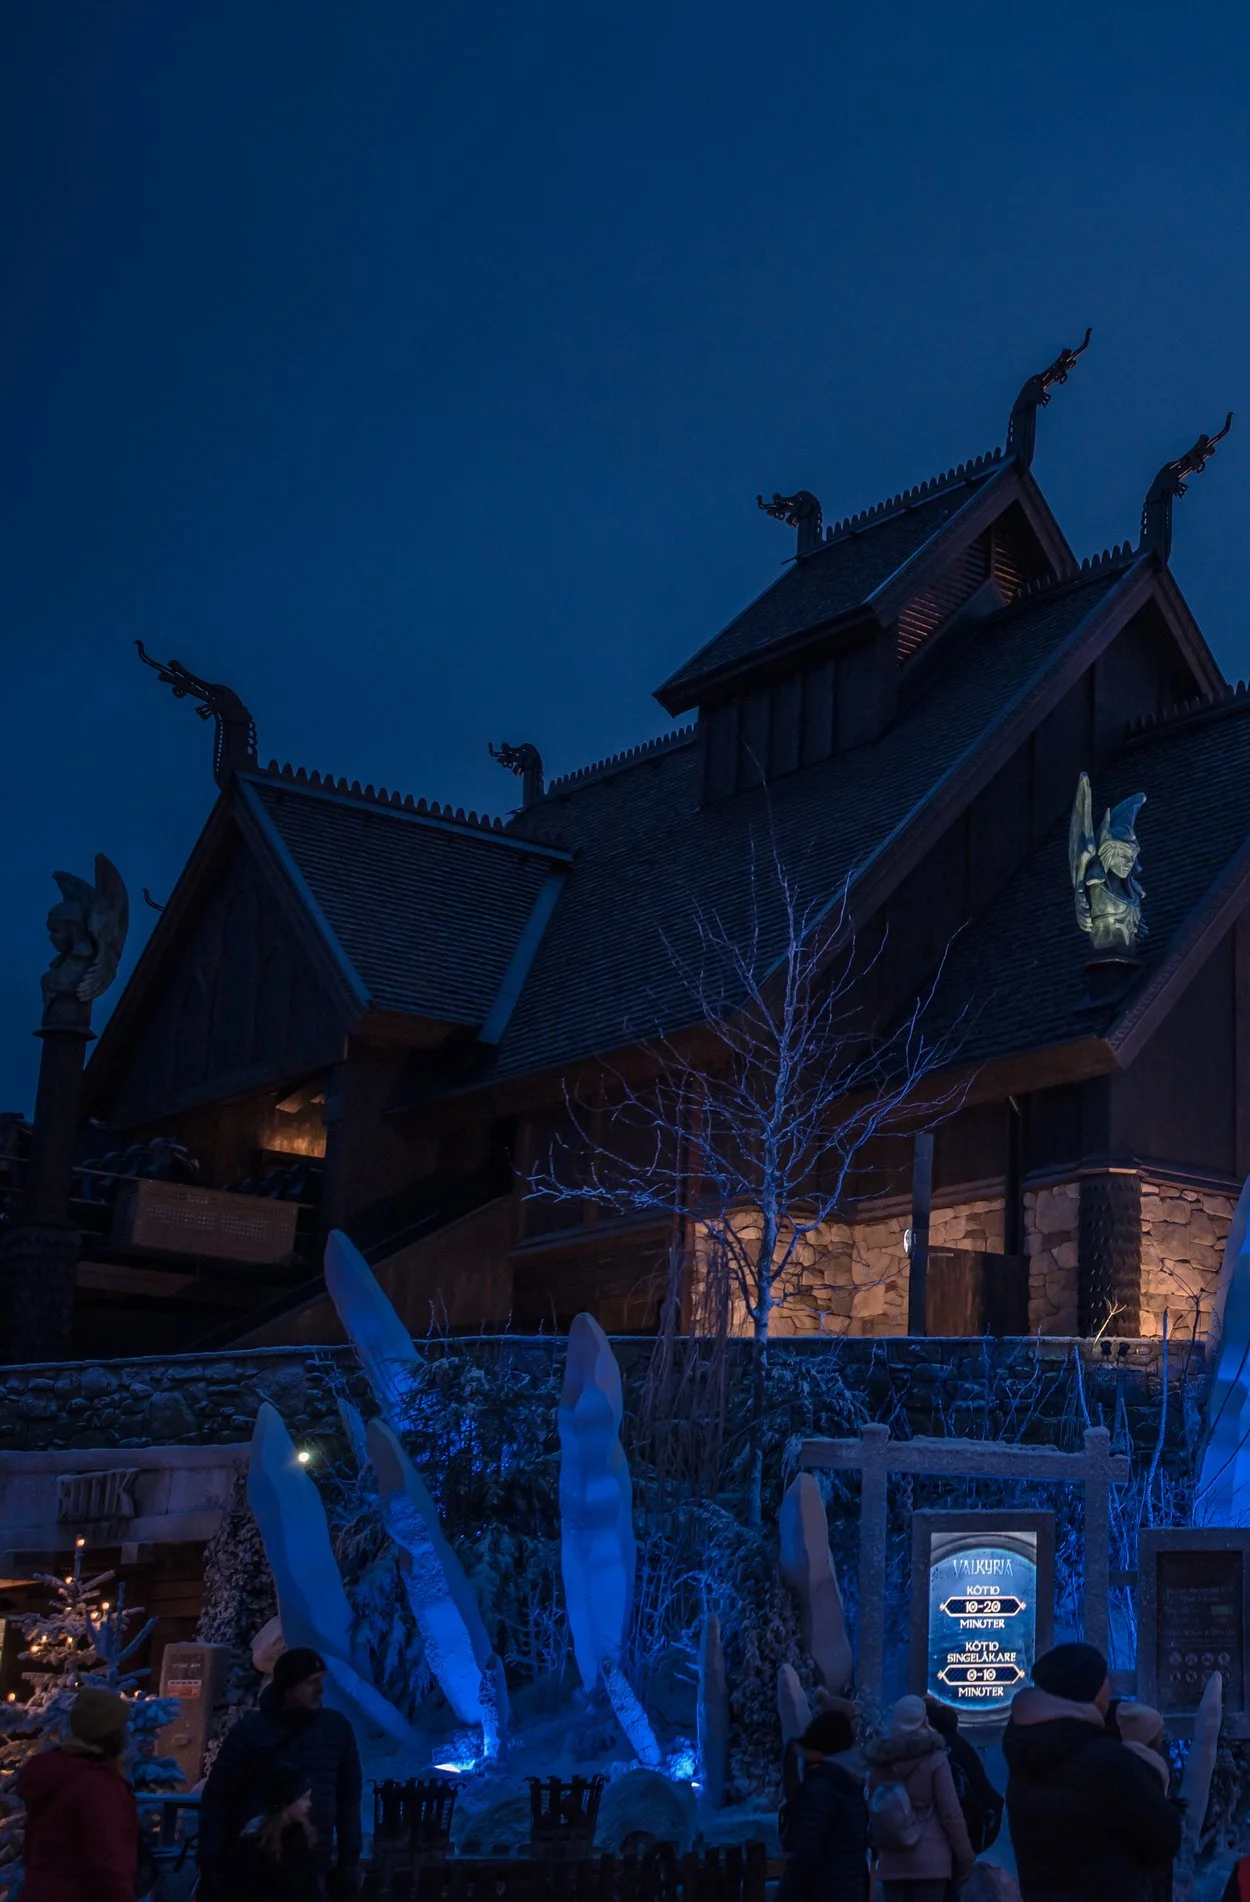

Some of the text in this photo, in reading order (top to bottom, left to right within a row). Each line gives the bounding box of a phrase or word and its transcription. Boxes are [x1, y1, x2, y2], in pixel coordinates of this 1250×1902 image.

[953, 1559, 1014, 1577] VALKYRIA
[966, 1584, 1000, 1595] KÖTID
[965, 1601, 1001, 1613] 10-20
[960, 1619, 1005, 1629] MINUTER
[965, 1641, 999, 1652] KÖTID
[947, 1651, 1017, 1663] SINGELÅKARE
[967, 1669, 996, 1681] 0-10
[958, 1687, 1004, 1697] MINUTER
